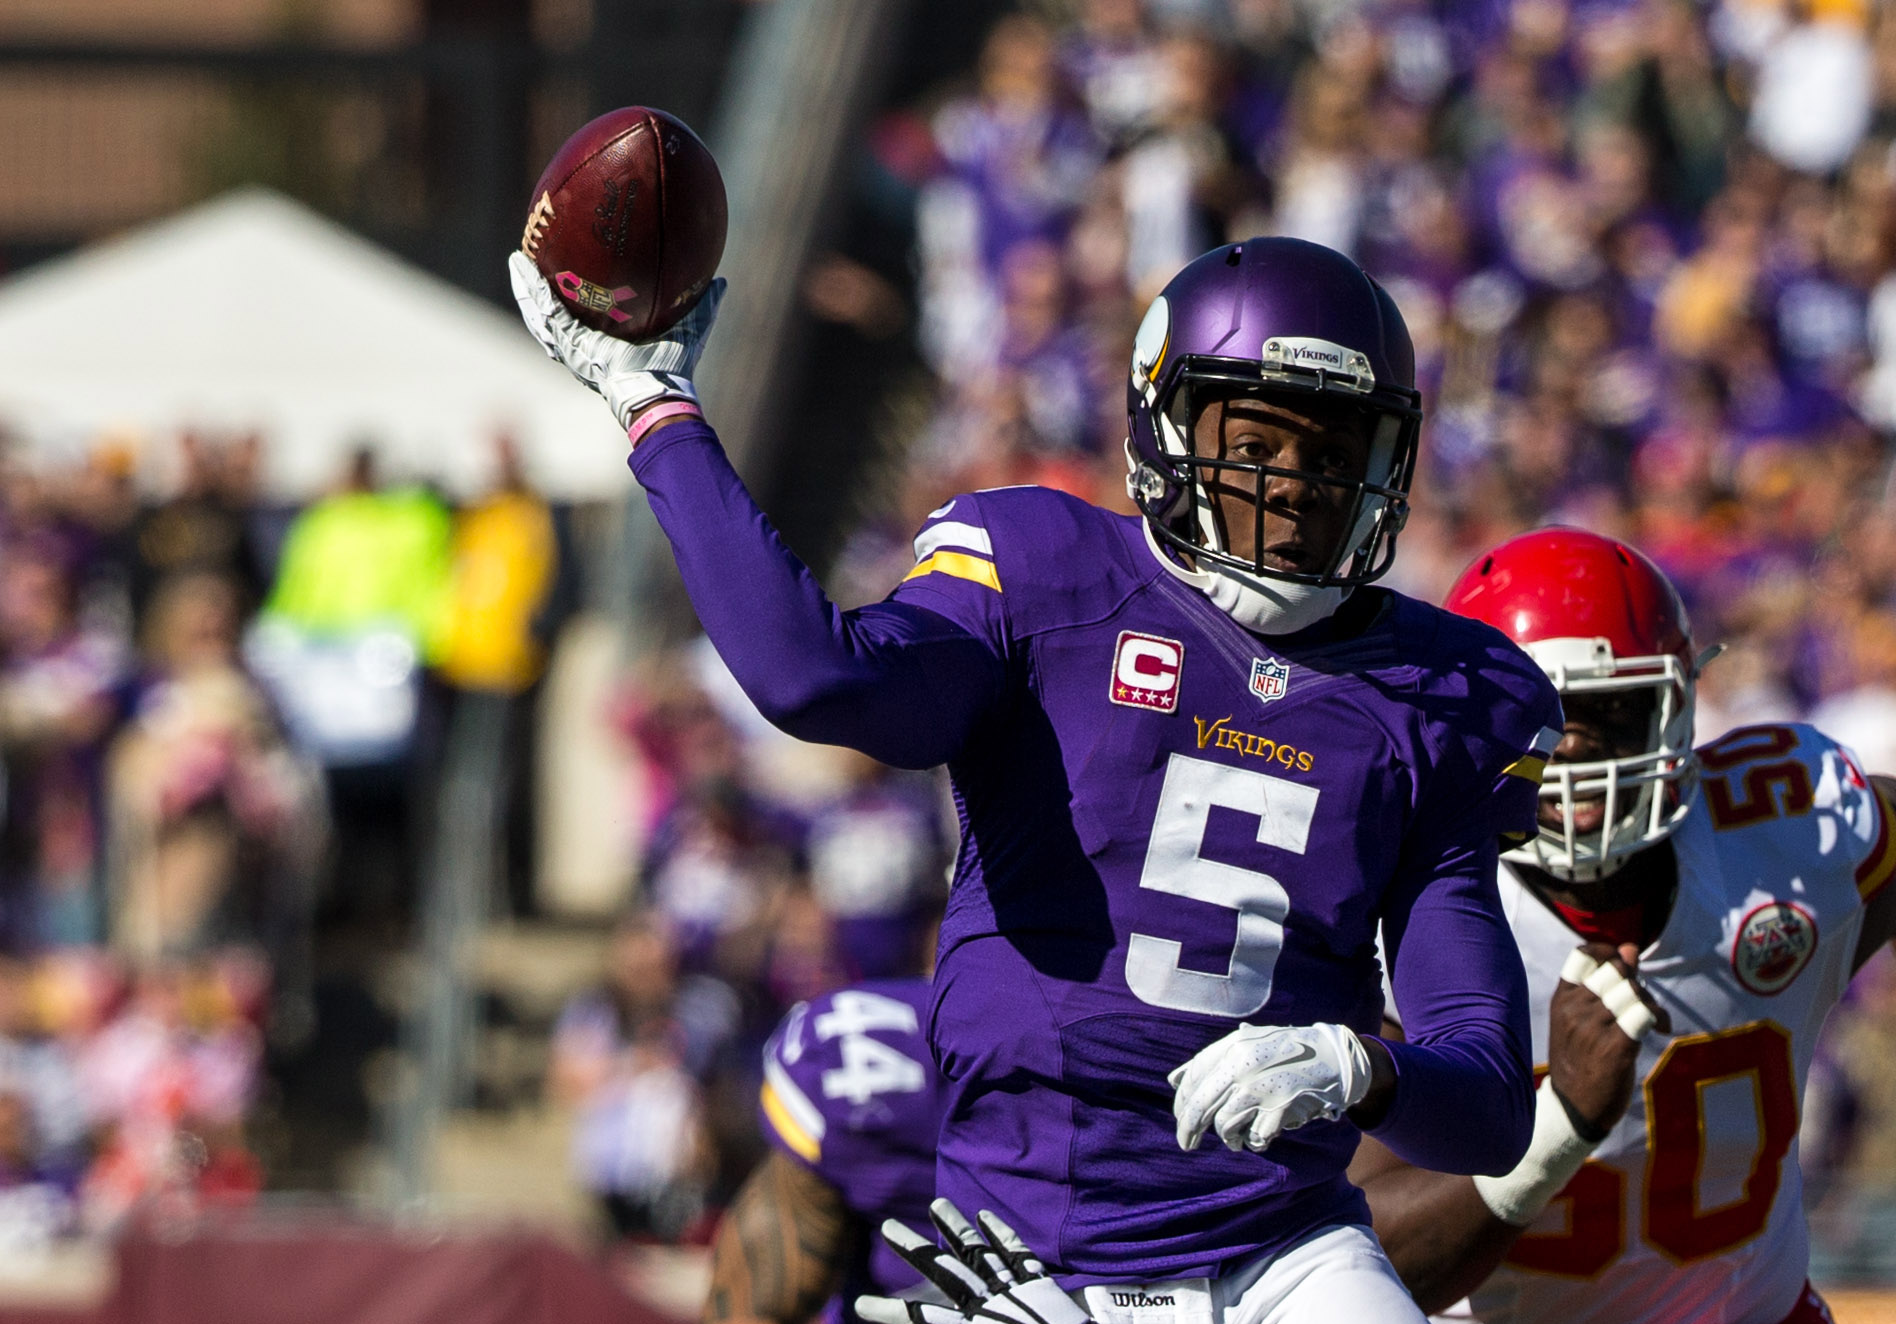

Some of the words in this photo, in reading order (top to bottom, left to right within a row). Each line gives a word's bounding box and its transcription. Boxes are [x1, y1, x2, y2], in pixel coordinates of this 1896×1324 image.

[1117, 638, 1179, 690] C
[1255, 674, 1281, 697] NFL
[1702, 722, 1812, 831] 50
[1125, 752, 1320, 1018] 5
[812, 990, 926, 1105] 44
[1111, 1292, 1175, 1307] Wilson
